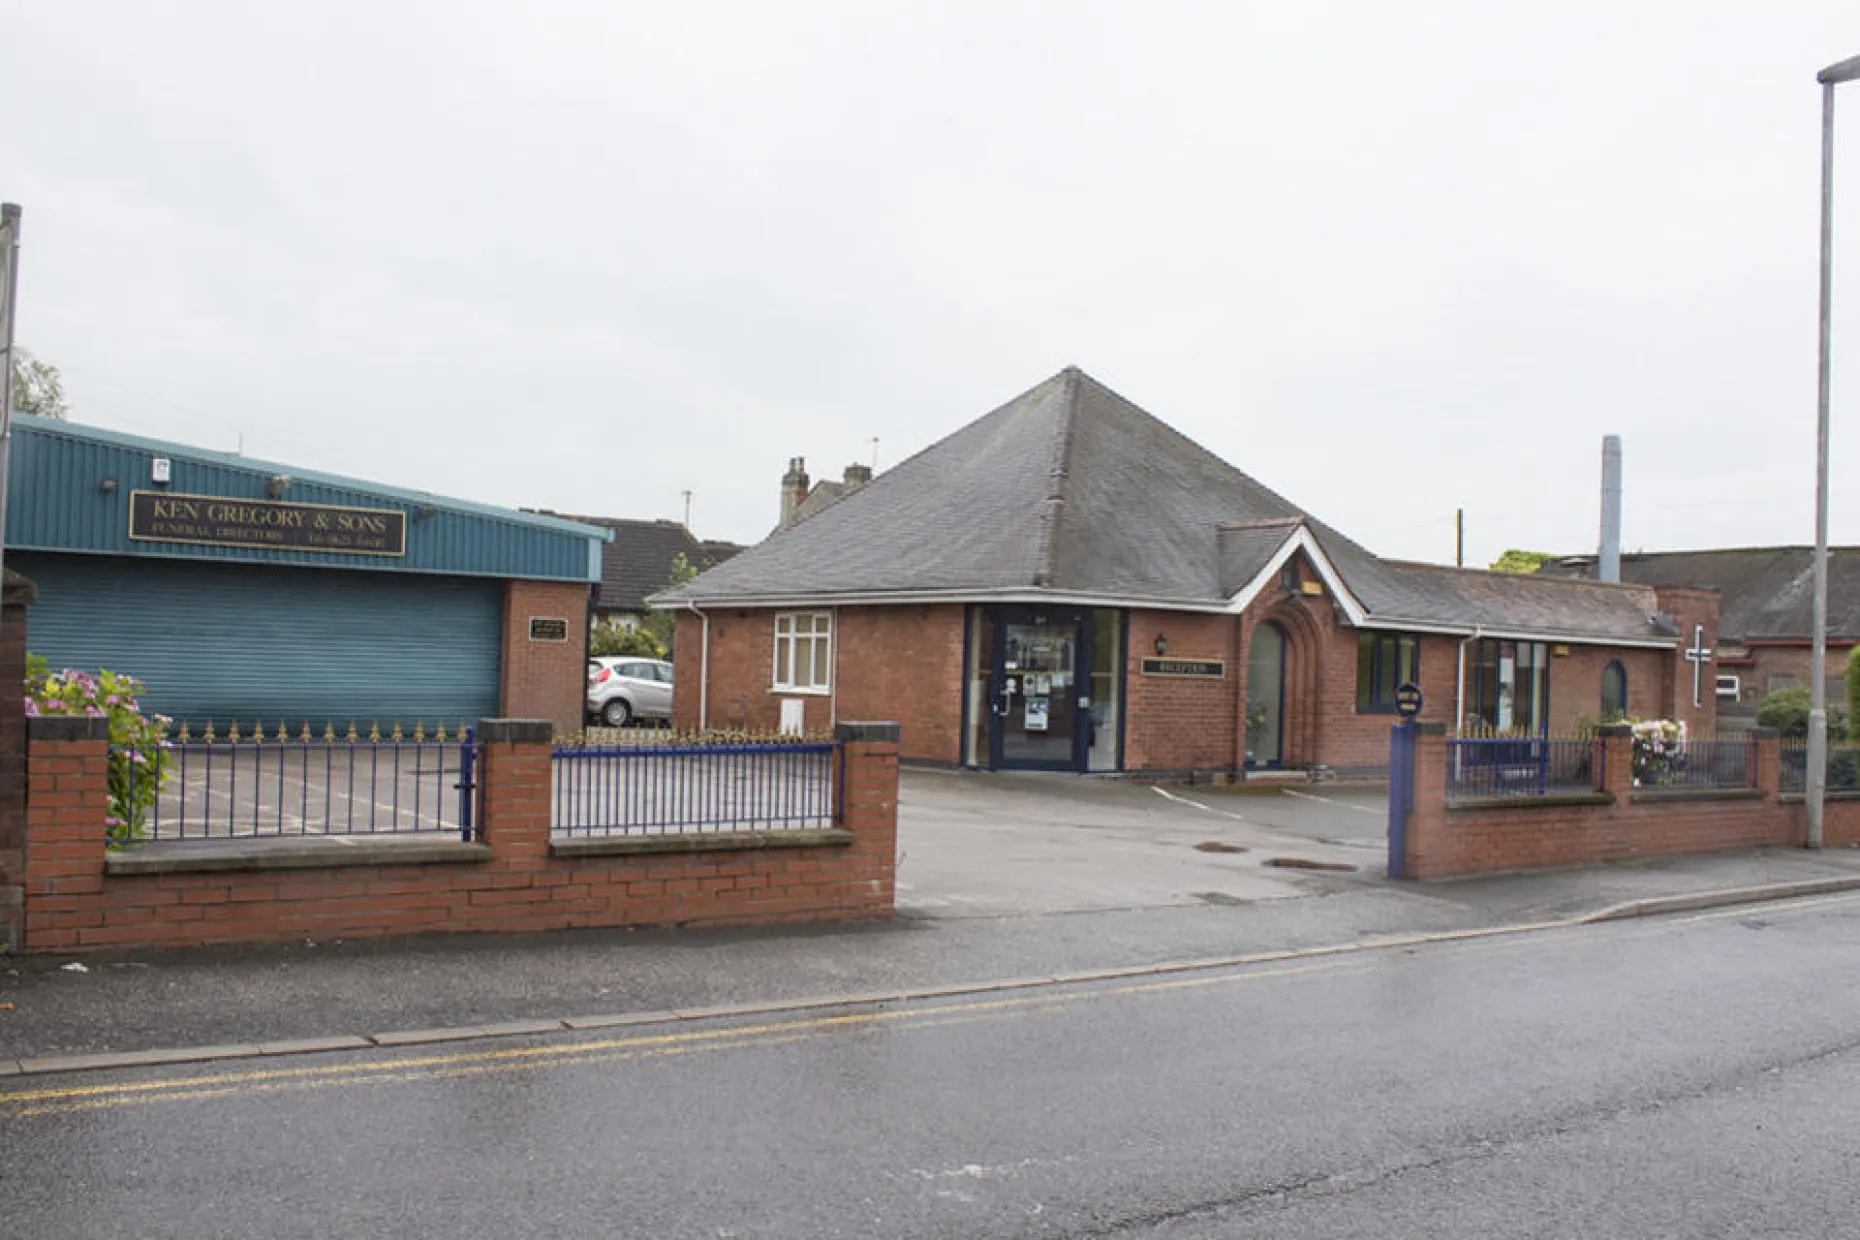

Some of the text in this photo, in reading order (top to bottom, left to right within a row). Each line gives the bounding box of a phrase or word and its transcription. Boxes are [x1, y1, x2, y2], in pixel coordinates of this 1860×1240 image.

[154, 499, 387, 533] KEN GREGORY & SONS
